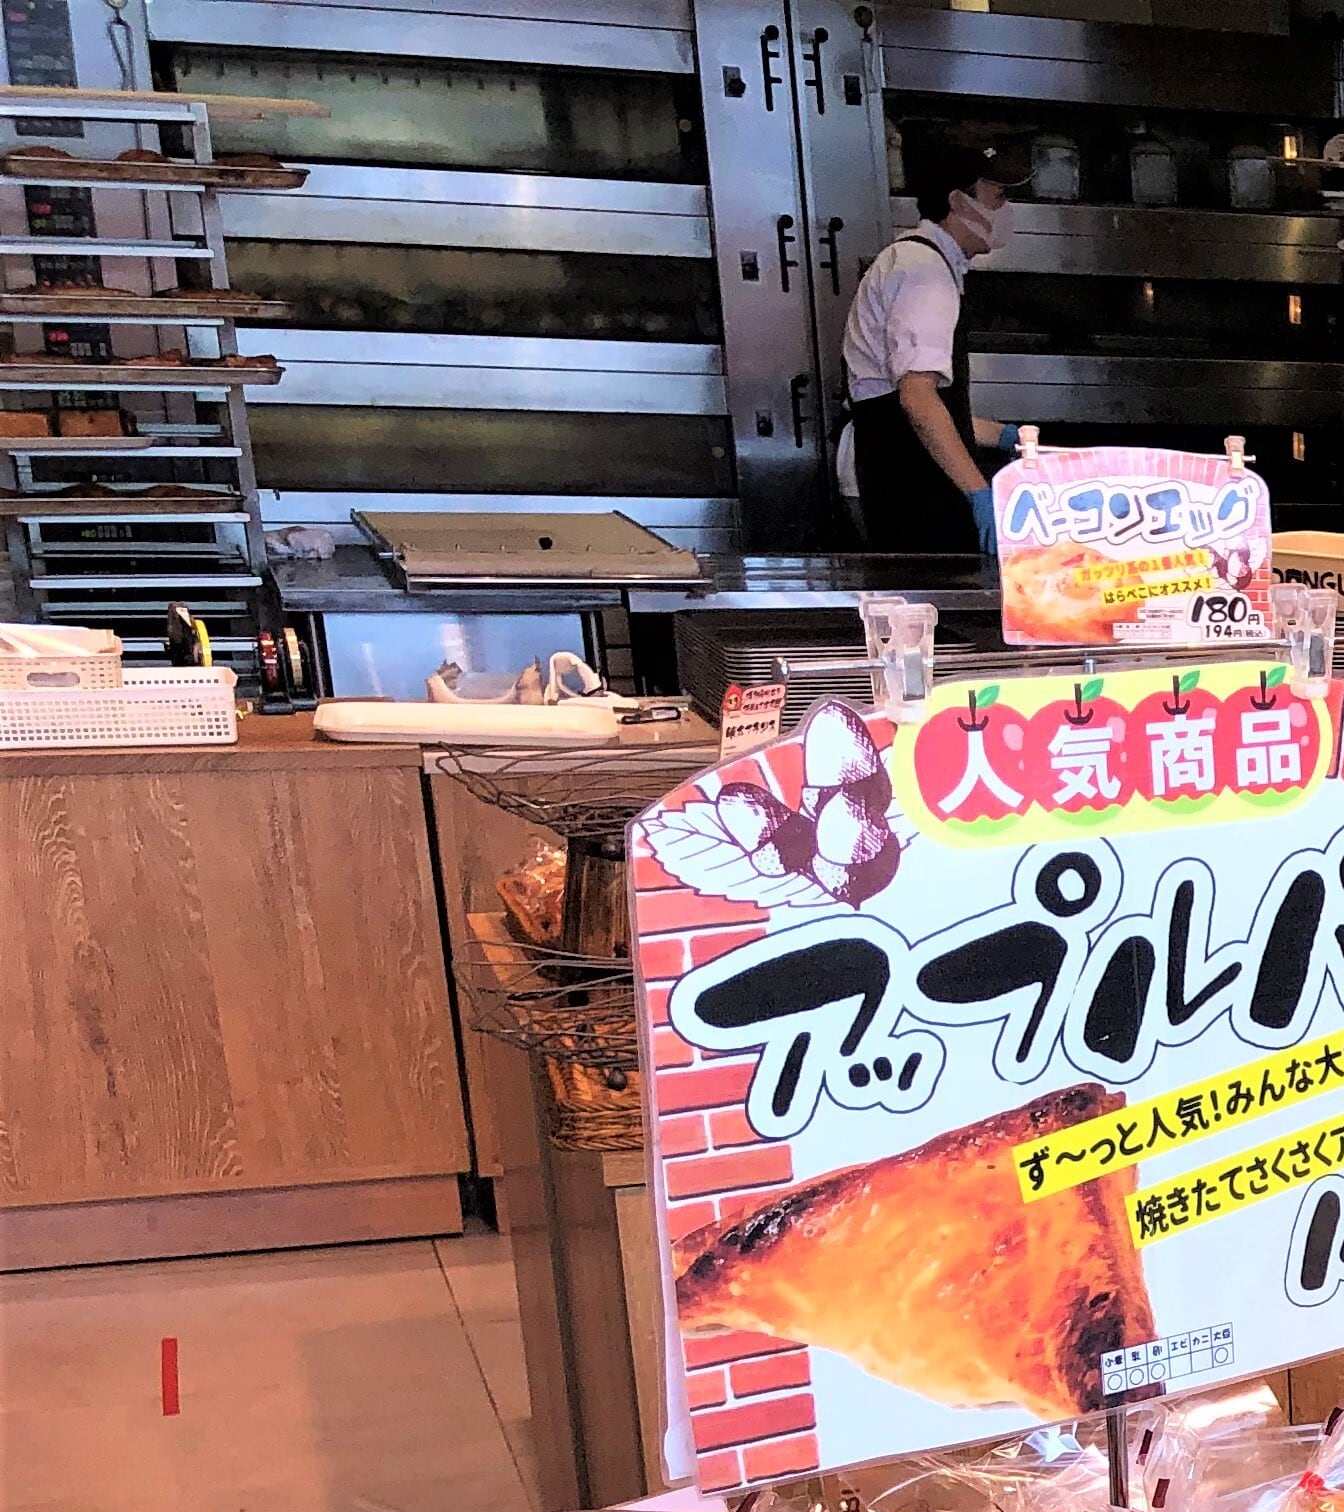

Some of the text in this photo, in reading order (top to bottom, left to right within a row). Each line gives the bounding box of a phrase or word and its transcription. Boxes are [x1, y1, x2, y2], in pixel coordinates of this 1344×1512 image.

[1010, 483, 1254, 541] ベーコンエッグ
[1191, 596, 1261, 625] 180円
[936, 705, 1305, 817] 人気商品
[1170, 1339, 1188, 1352] エビ
